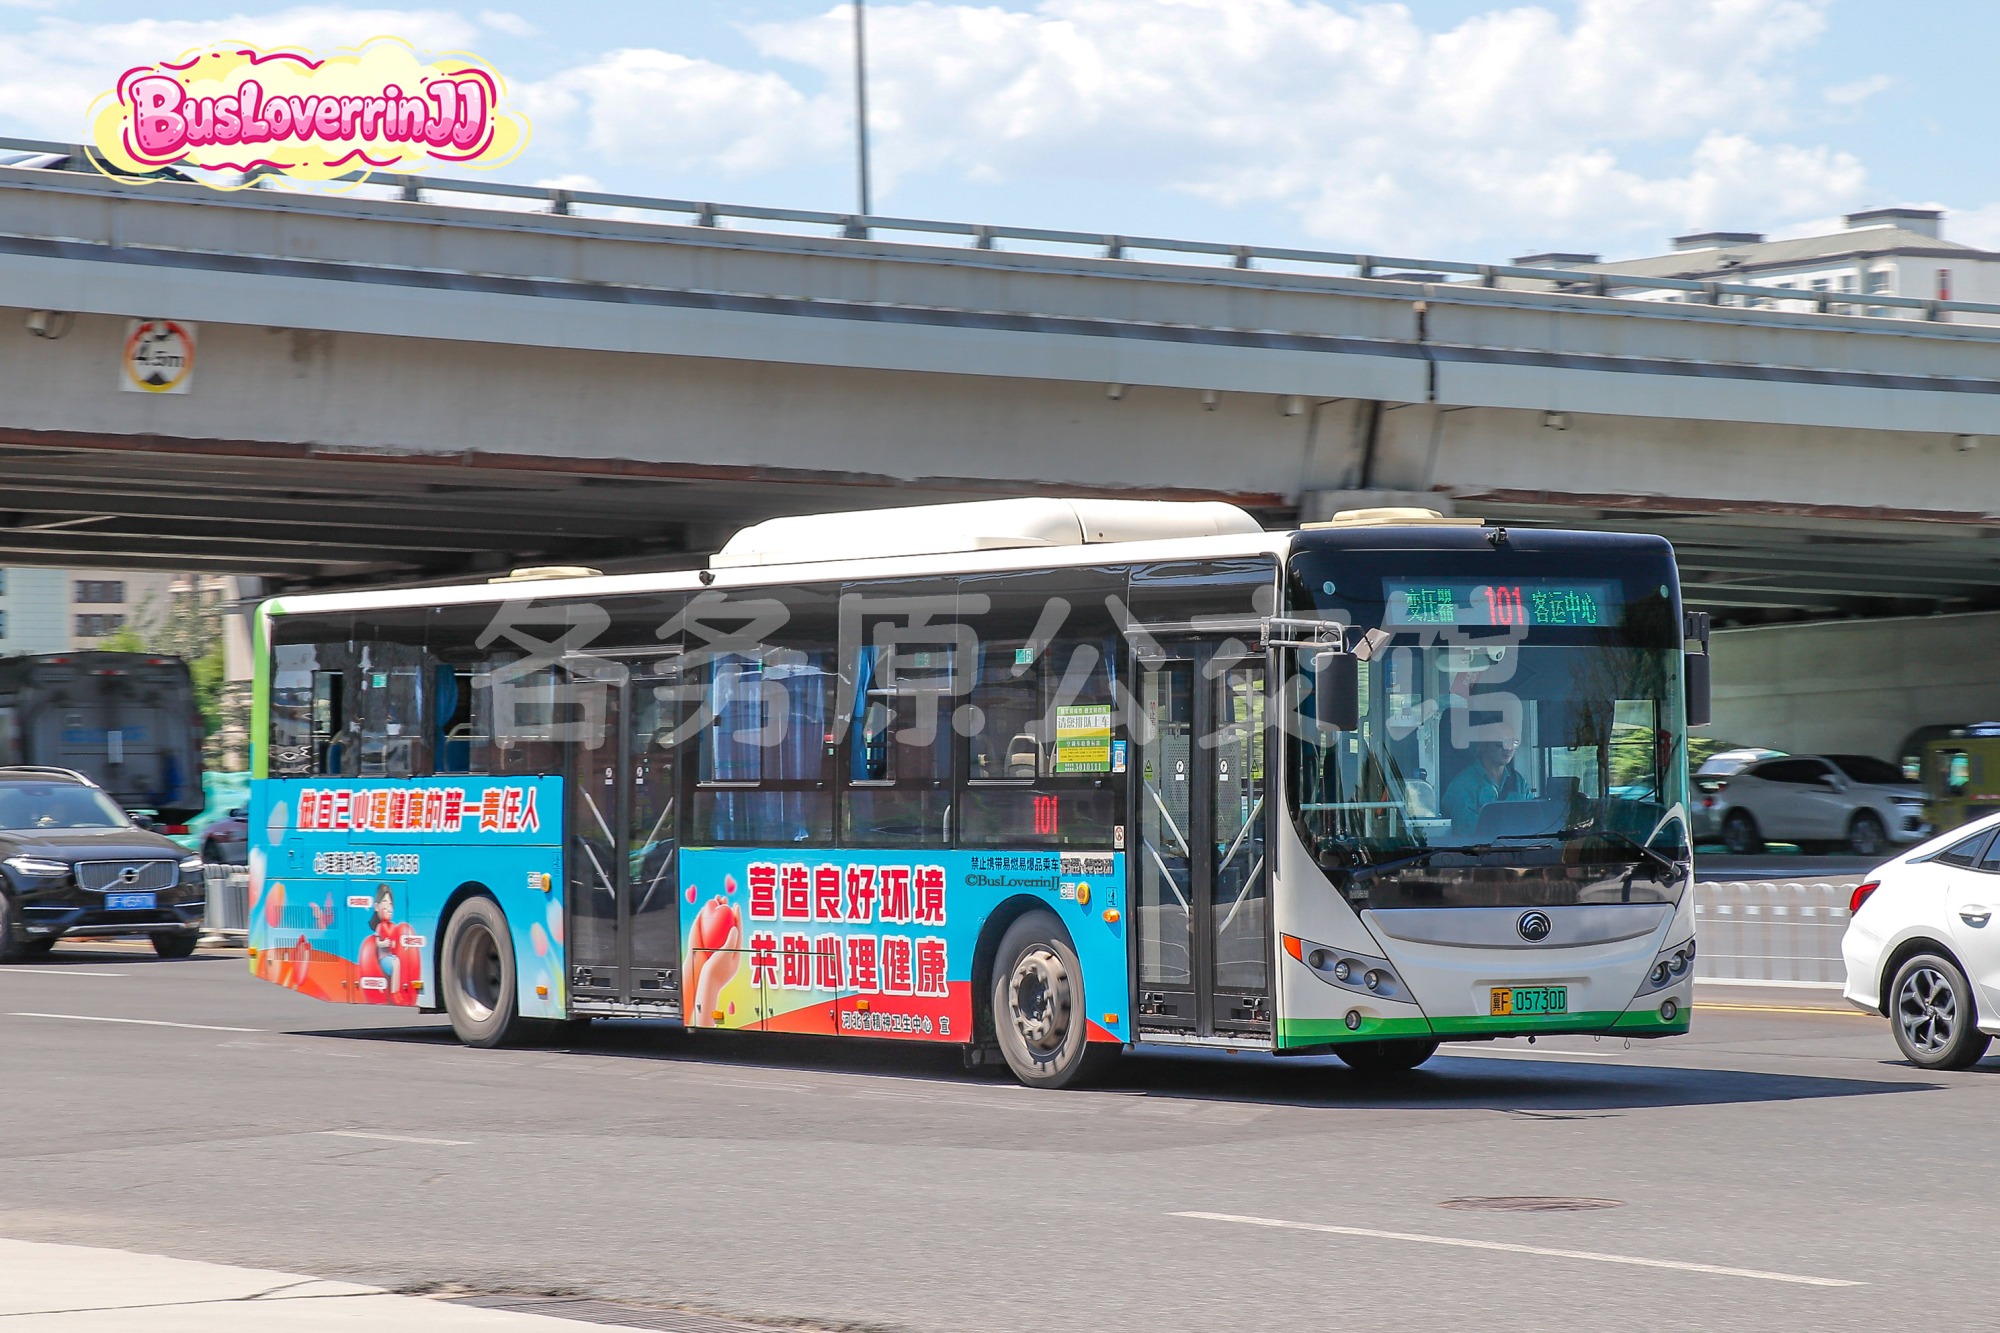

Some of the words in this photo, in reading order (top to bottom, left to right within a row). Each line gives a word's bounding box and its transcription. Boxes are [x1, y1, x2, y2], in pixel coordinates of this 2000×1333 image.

[131, 338, 185, 369] 4.5m
[1484, 586, 1523, 625] 101
[1532, 590, 1597, 624] 客运中心
[1058, 716, 1110, 728] 请您排队上车
[297, 787, 540, 832] 做自己心理健康的第一责任人
[1033, 795, 1059, 835] 101
[971, 856, 1059, 872] 禁止携带易燃易爆品乘车
[748, 862, 946, 925] 营造良好环境
[749, 933, 949, 996] 共助心理健康
[841, 1010, 933, 1034] 河北省精神卫生中心
[939, 1015, 951, 1035] 宣
